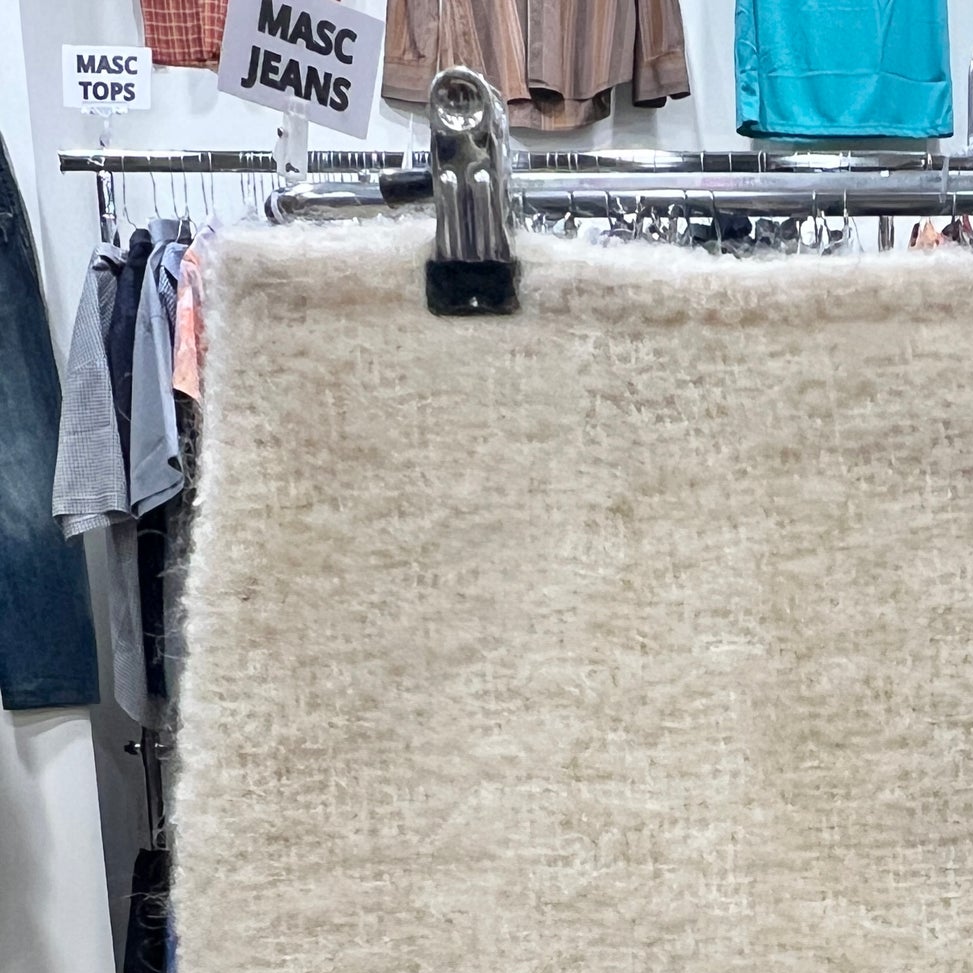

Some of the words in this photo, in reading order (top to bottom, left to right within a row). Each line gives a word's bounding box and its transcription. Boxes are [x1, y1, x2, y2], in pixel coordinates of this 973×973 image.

[258, 0, 358, 65] MASC
[76, 54, 138, 75] MASC
[240, 45, 352, 112] JEANS
[78, 81, 136, 102] TOPS
